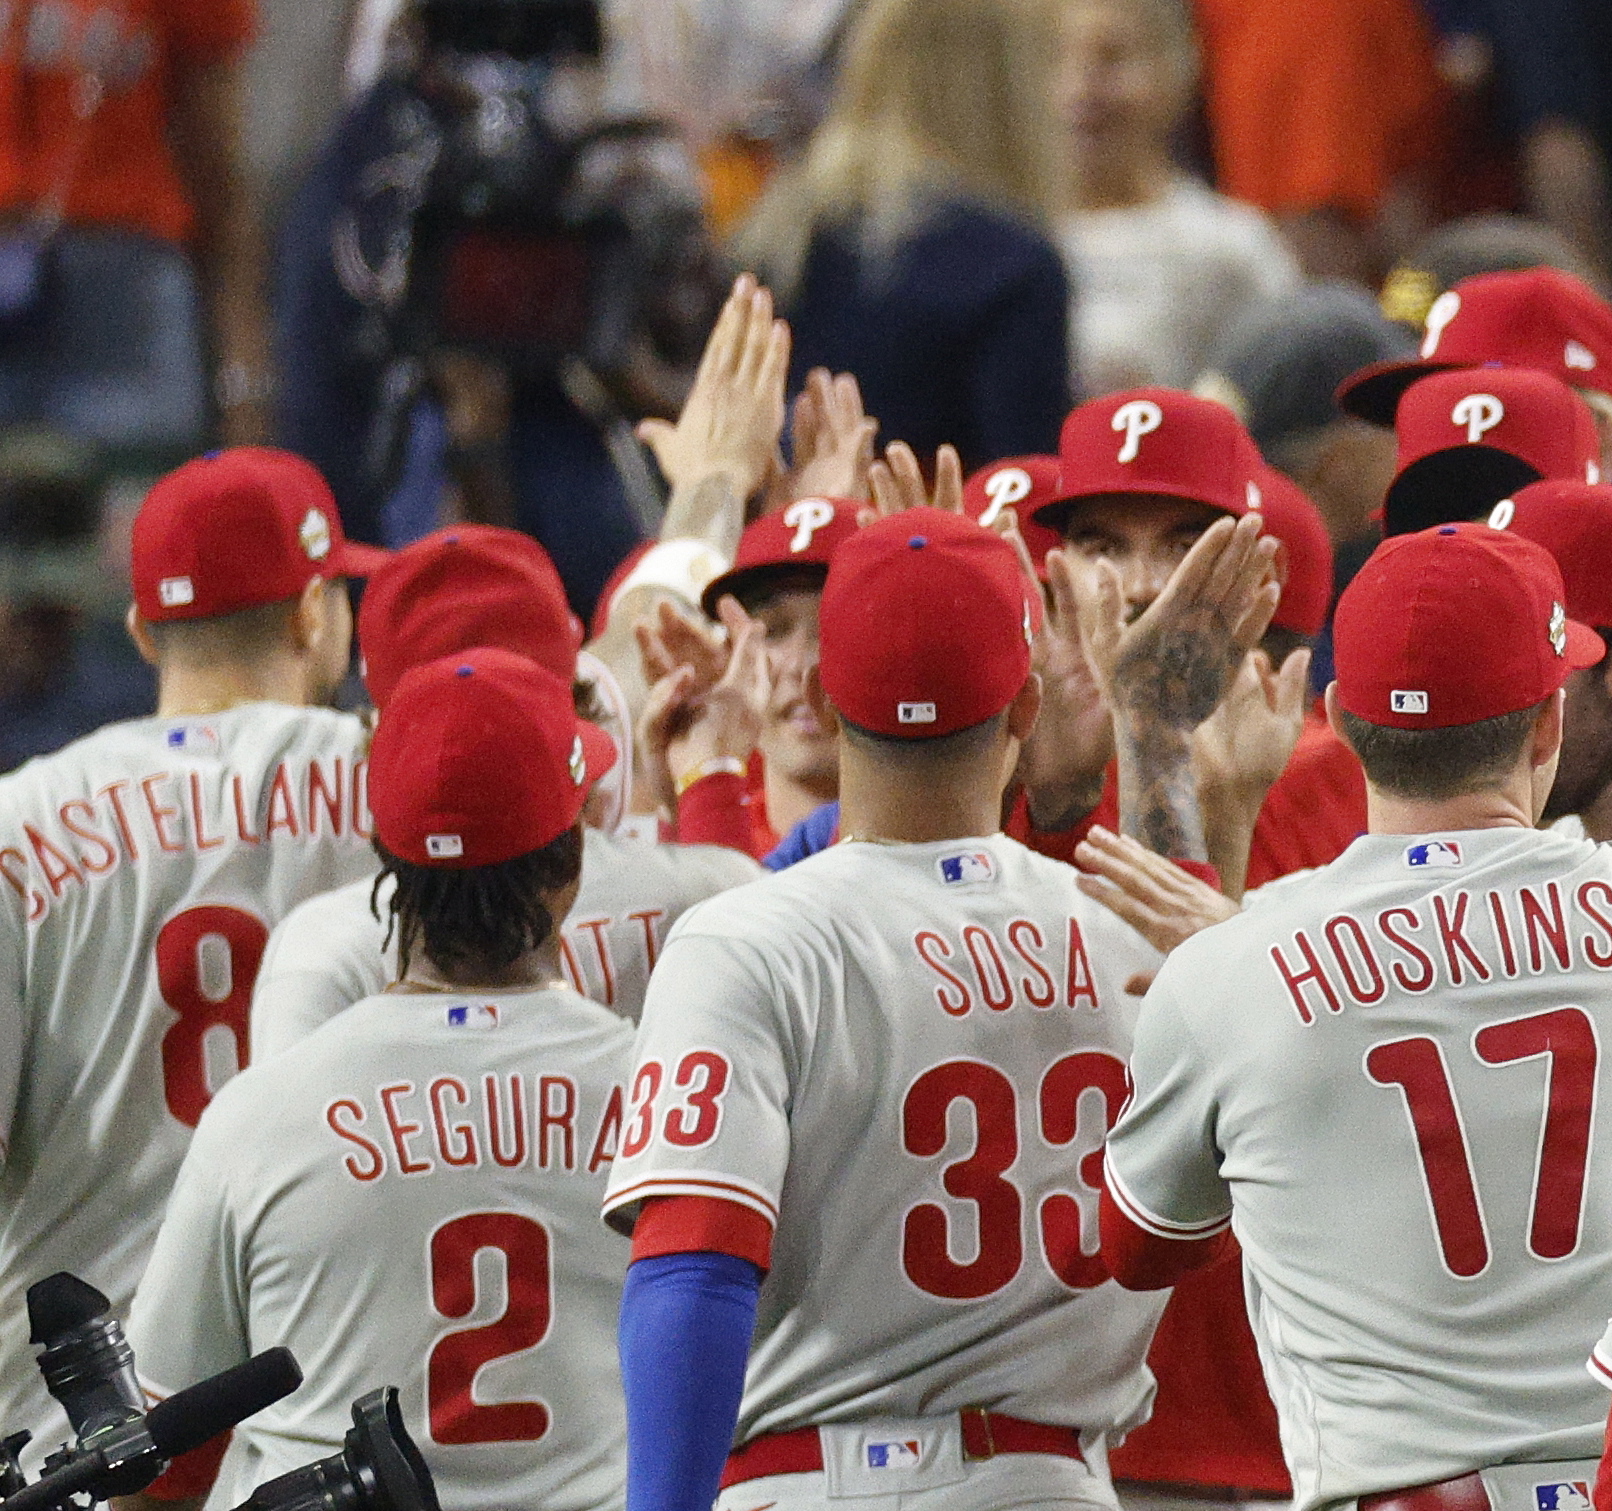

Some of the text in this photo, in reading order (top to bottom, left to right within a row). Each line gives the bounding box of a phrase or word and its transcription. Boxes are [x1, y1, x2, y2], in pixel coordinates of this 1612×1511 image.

[1111, 400, 1163, 463] P
[1452, 393, 1504, 444] P
[784, 498, 835, 553] P
[979, 467, 1032, 527] P
[155, 901, 270, 1129] 8
[914, 914, 1101, 1018] SOSA
[326, 1072, 623, 1183] SEGURA
[622, 1049, 732, 1160] 33
[1362, 1003, 1600, 1280] 17
[900, 1047, 1134, 1300] 33
[425, 1209, 554, 1446] 2
